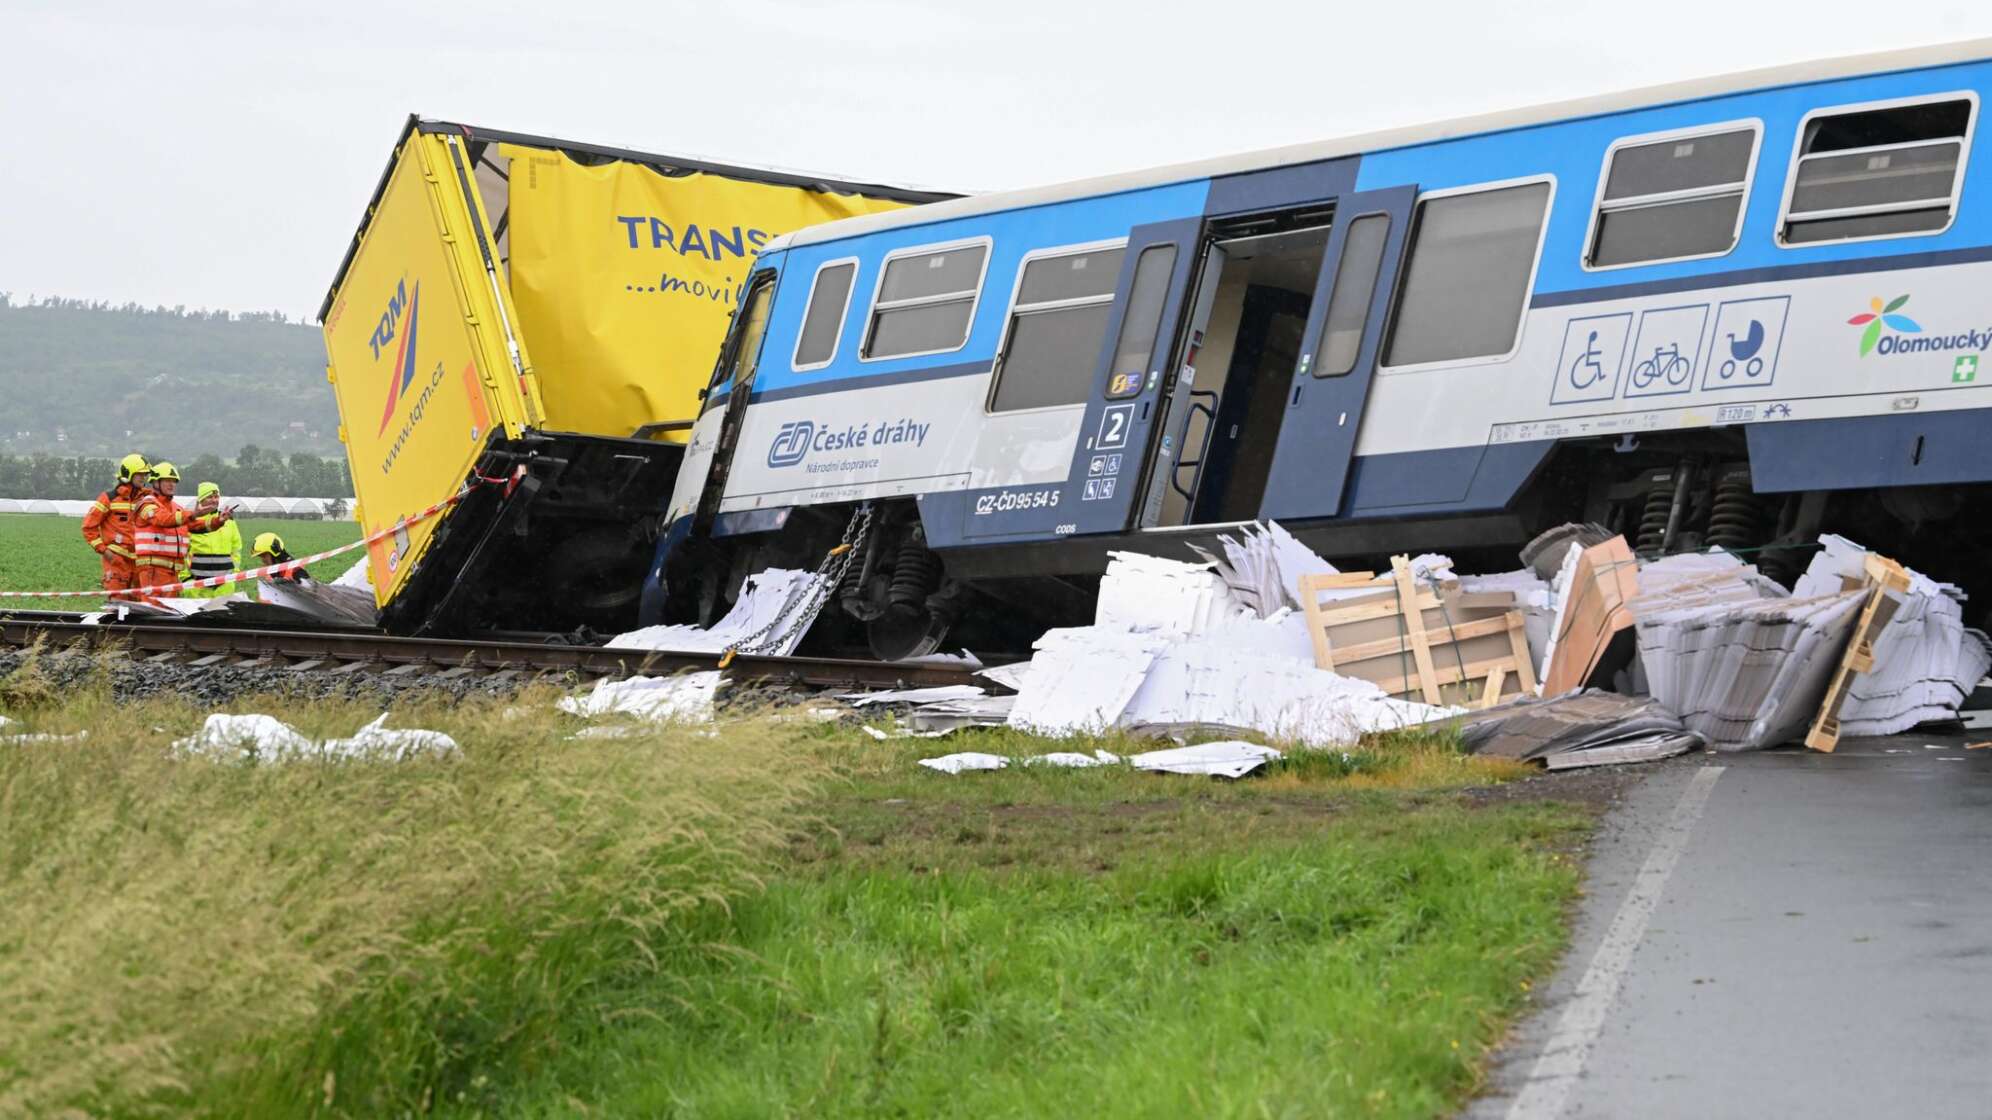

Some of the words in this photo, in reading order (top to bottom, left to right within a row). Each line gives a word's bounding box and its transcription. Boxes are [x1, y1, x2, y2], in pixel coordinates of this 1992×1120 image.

[617, 216, 780, 261] TRANS
[369, 276, 407, 362] TQM
[1877, 327, 1992, 355] Olomoucký
[382, 361, 445, 474] www.tqm.cz
[1105, 412, 1124, 442] 2
[813, 422, 868, 452] České
[872, 418, 931, 448] dráhy
[805, 461, 839, 474] Národní
[840, 458, 880, 474] dopravce
